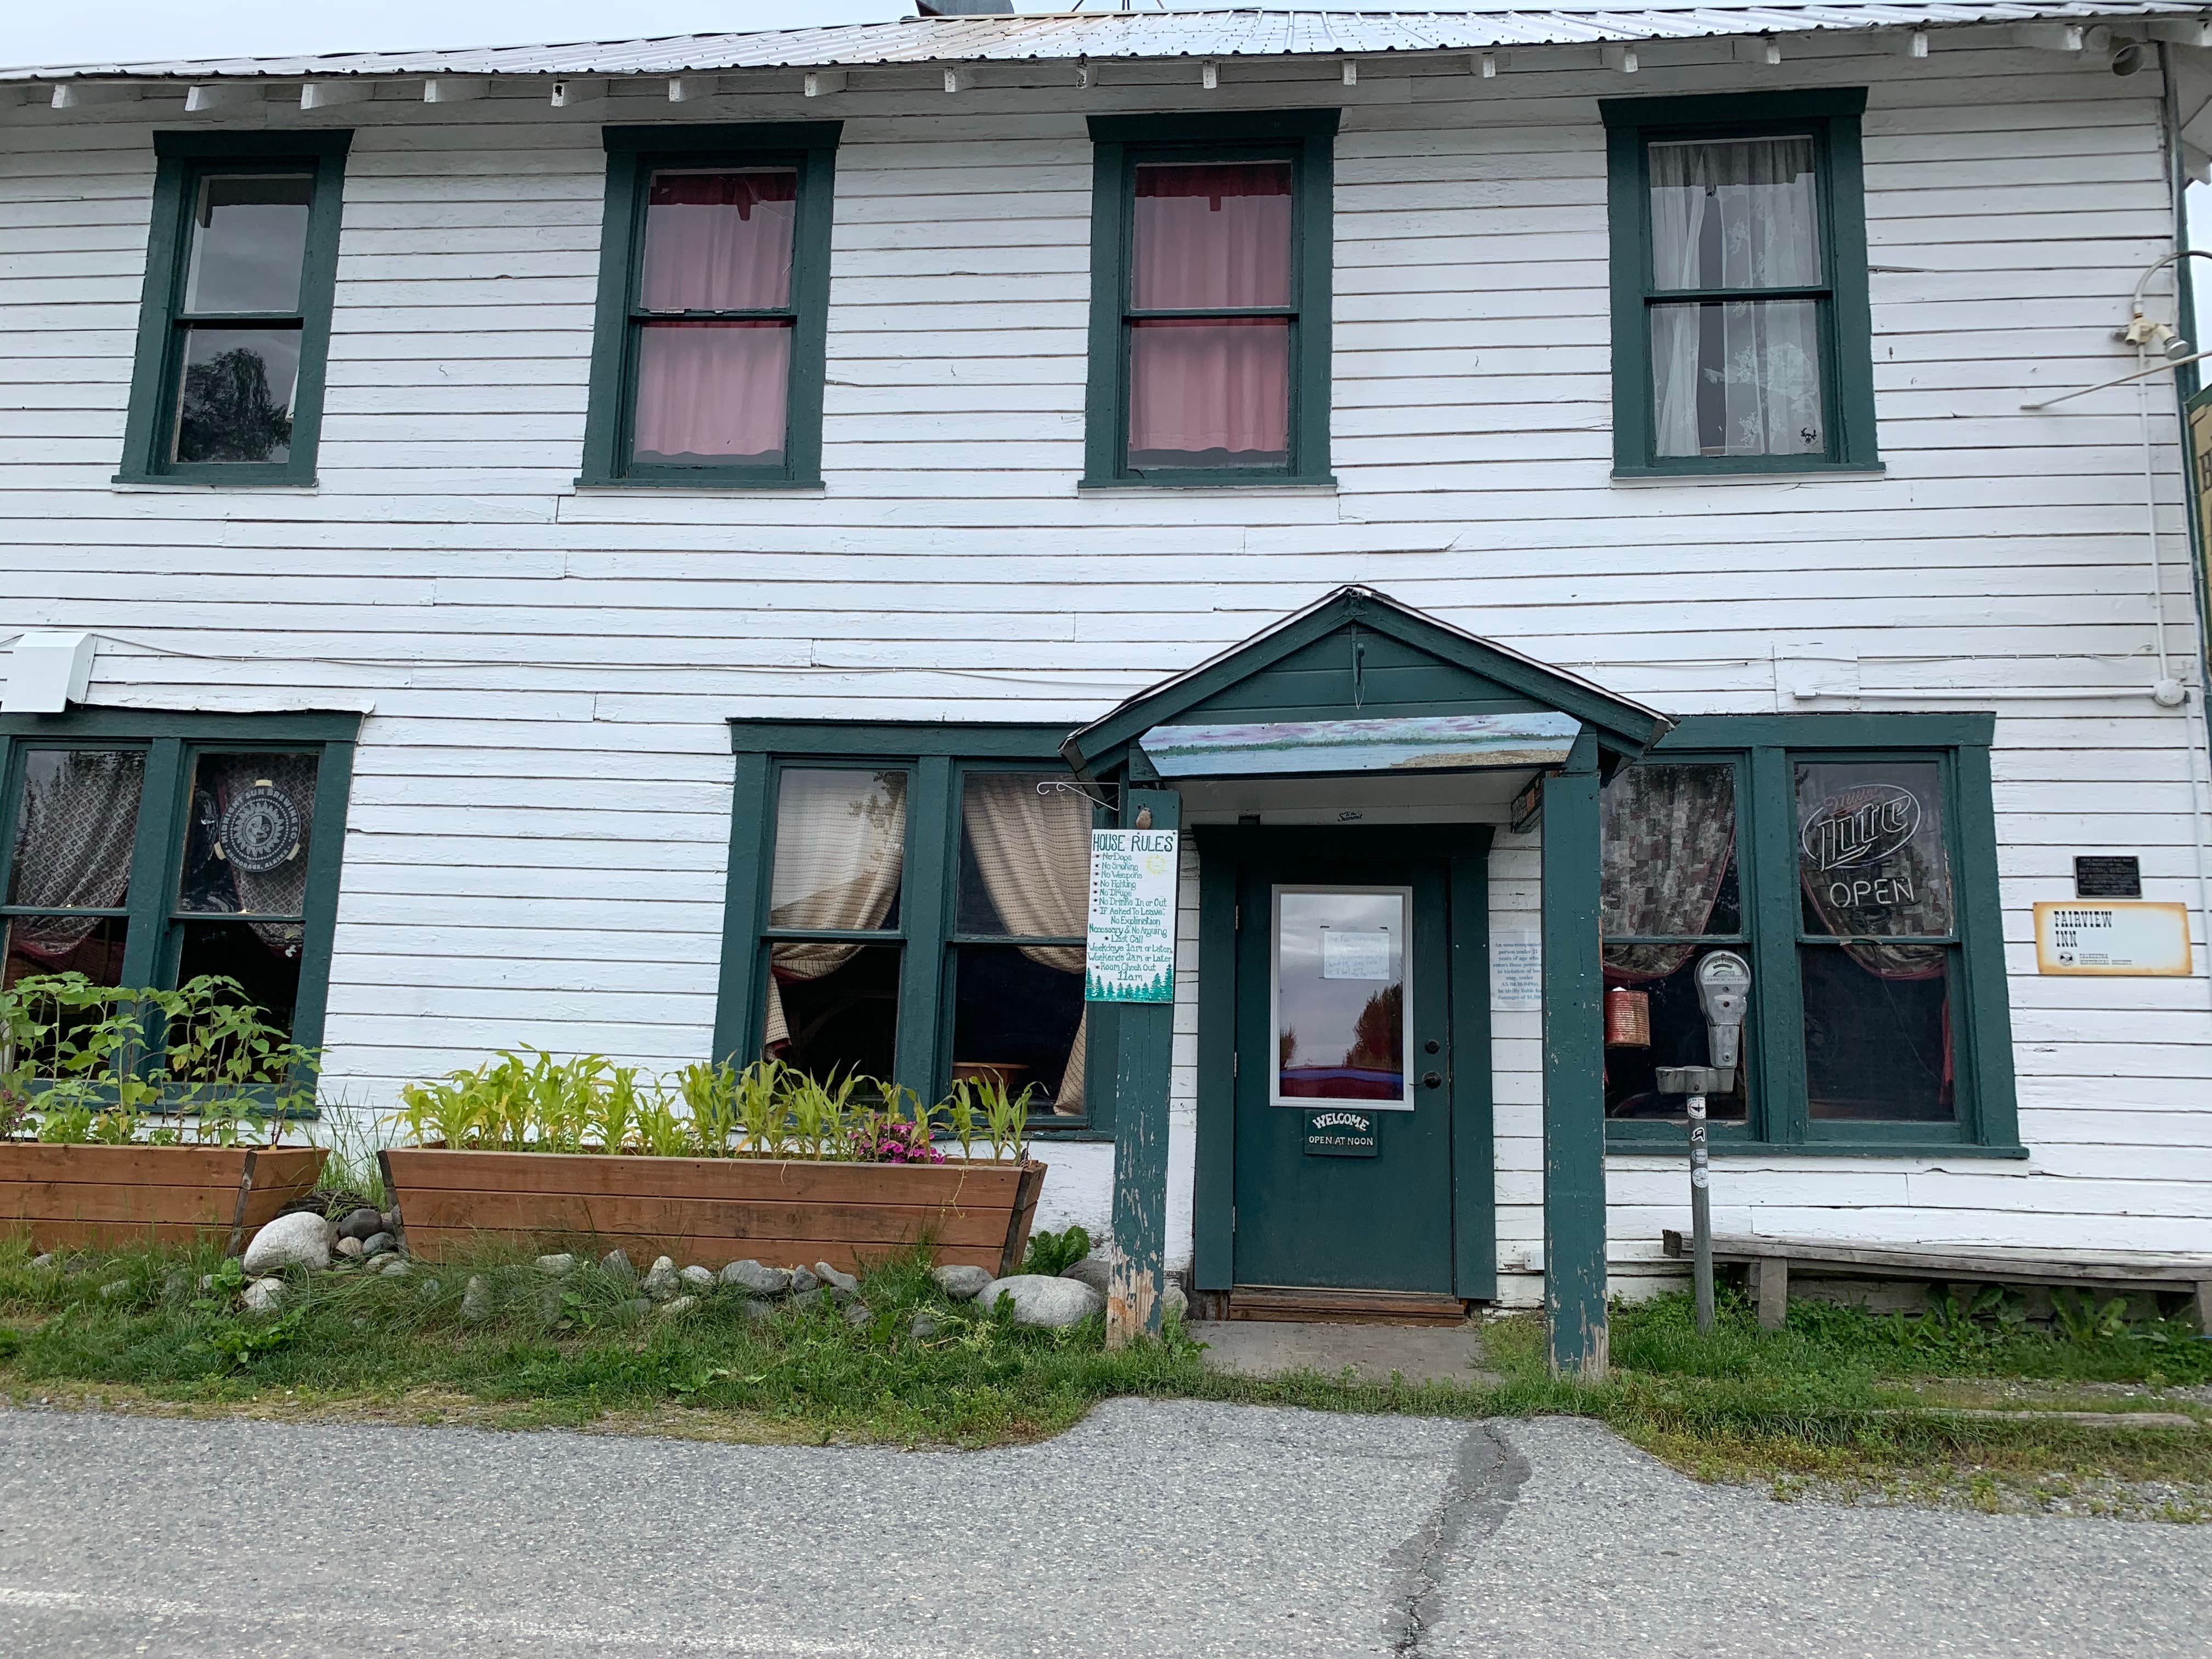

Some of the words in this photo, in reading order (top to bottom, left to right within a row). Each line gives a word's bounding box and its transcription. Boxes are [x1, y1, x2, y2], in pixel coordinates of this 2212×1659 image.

[221, 796, 244, 843] MIDNIGHT
[245, 788, 264, 798] SUN
[267, 788, 298, 823] BREWING
[1817, 795, 1911, 871] Lite
[1093, 834, 1125, 851] HOUSE
[1131, 835, 1173, 852] RULES
[1113, 853, 1132, 864] Dogs
[1102, 861, 1110, 870] No
[1112, 862, 1138, 873] Smoking
[1111, 871, 1142, 881] Weapons
[1111, 880, 1136, 890] Fighting
[1110, 889, 1132, 899] Drugs
[1830, 878, 1914, 907] OPEN
[1109, 898, 1133, 906] Drinks
[1135, 898, 1144, 906] In
[1154, 898, 1167, 907] Out
[1110, 907, 1131, 915] Asked
[2054, 911, 2112, 928] FAIRVIEW
[1089, 923, 1123, 936] Necessary
[1125, 926, 1130, 934] &
[1140, 926, 1167, 938] Arguing
[1111, 934, 1128, 943] Last
[1130, 935, 1143, 943] Call
[2055, 930, 2078, 947] INN
[1087, 943, 1124, 953] Weekdays
[1126, 944, 1142, 952] 1am
[1088, 952, 1124, 961] Weekends
[1126, 953, 1142, 961] 2am
[1101, 962, 1120, 970] Room
[1121, 963, 1142, 971] Check
[1117, 970, 1142, 981] 11am
[1312, 1113, 1370, 1131] WELCOME
[1309, 1136, 1332, 1144] OPEN
[1335, 1137, 1346, 1145] AT
[1347, 1137, 1374, 1146] NOON
